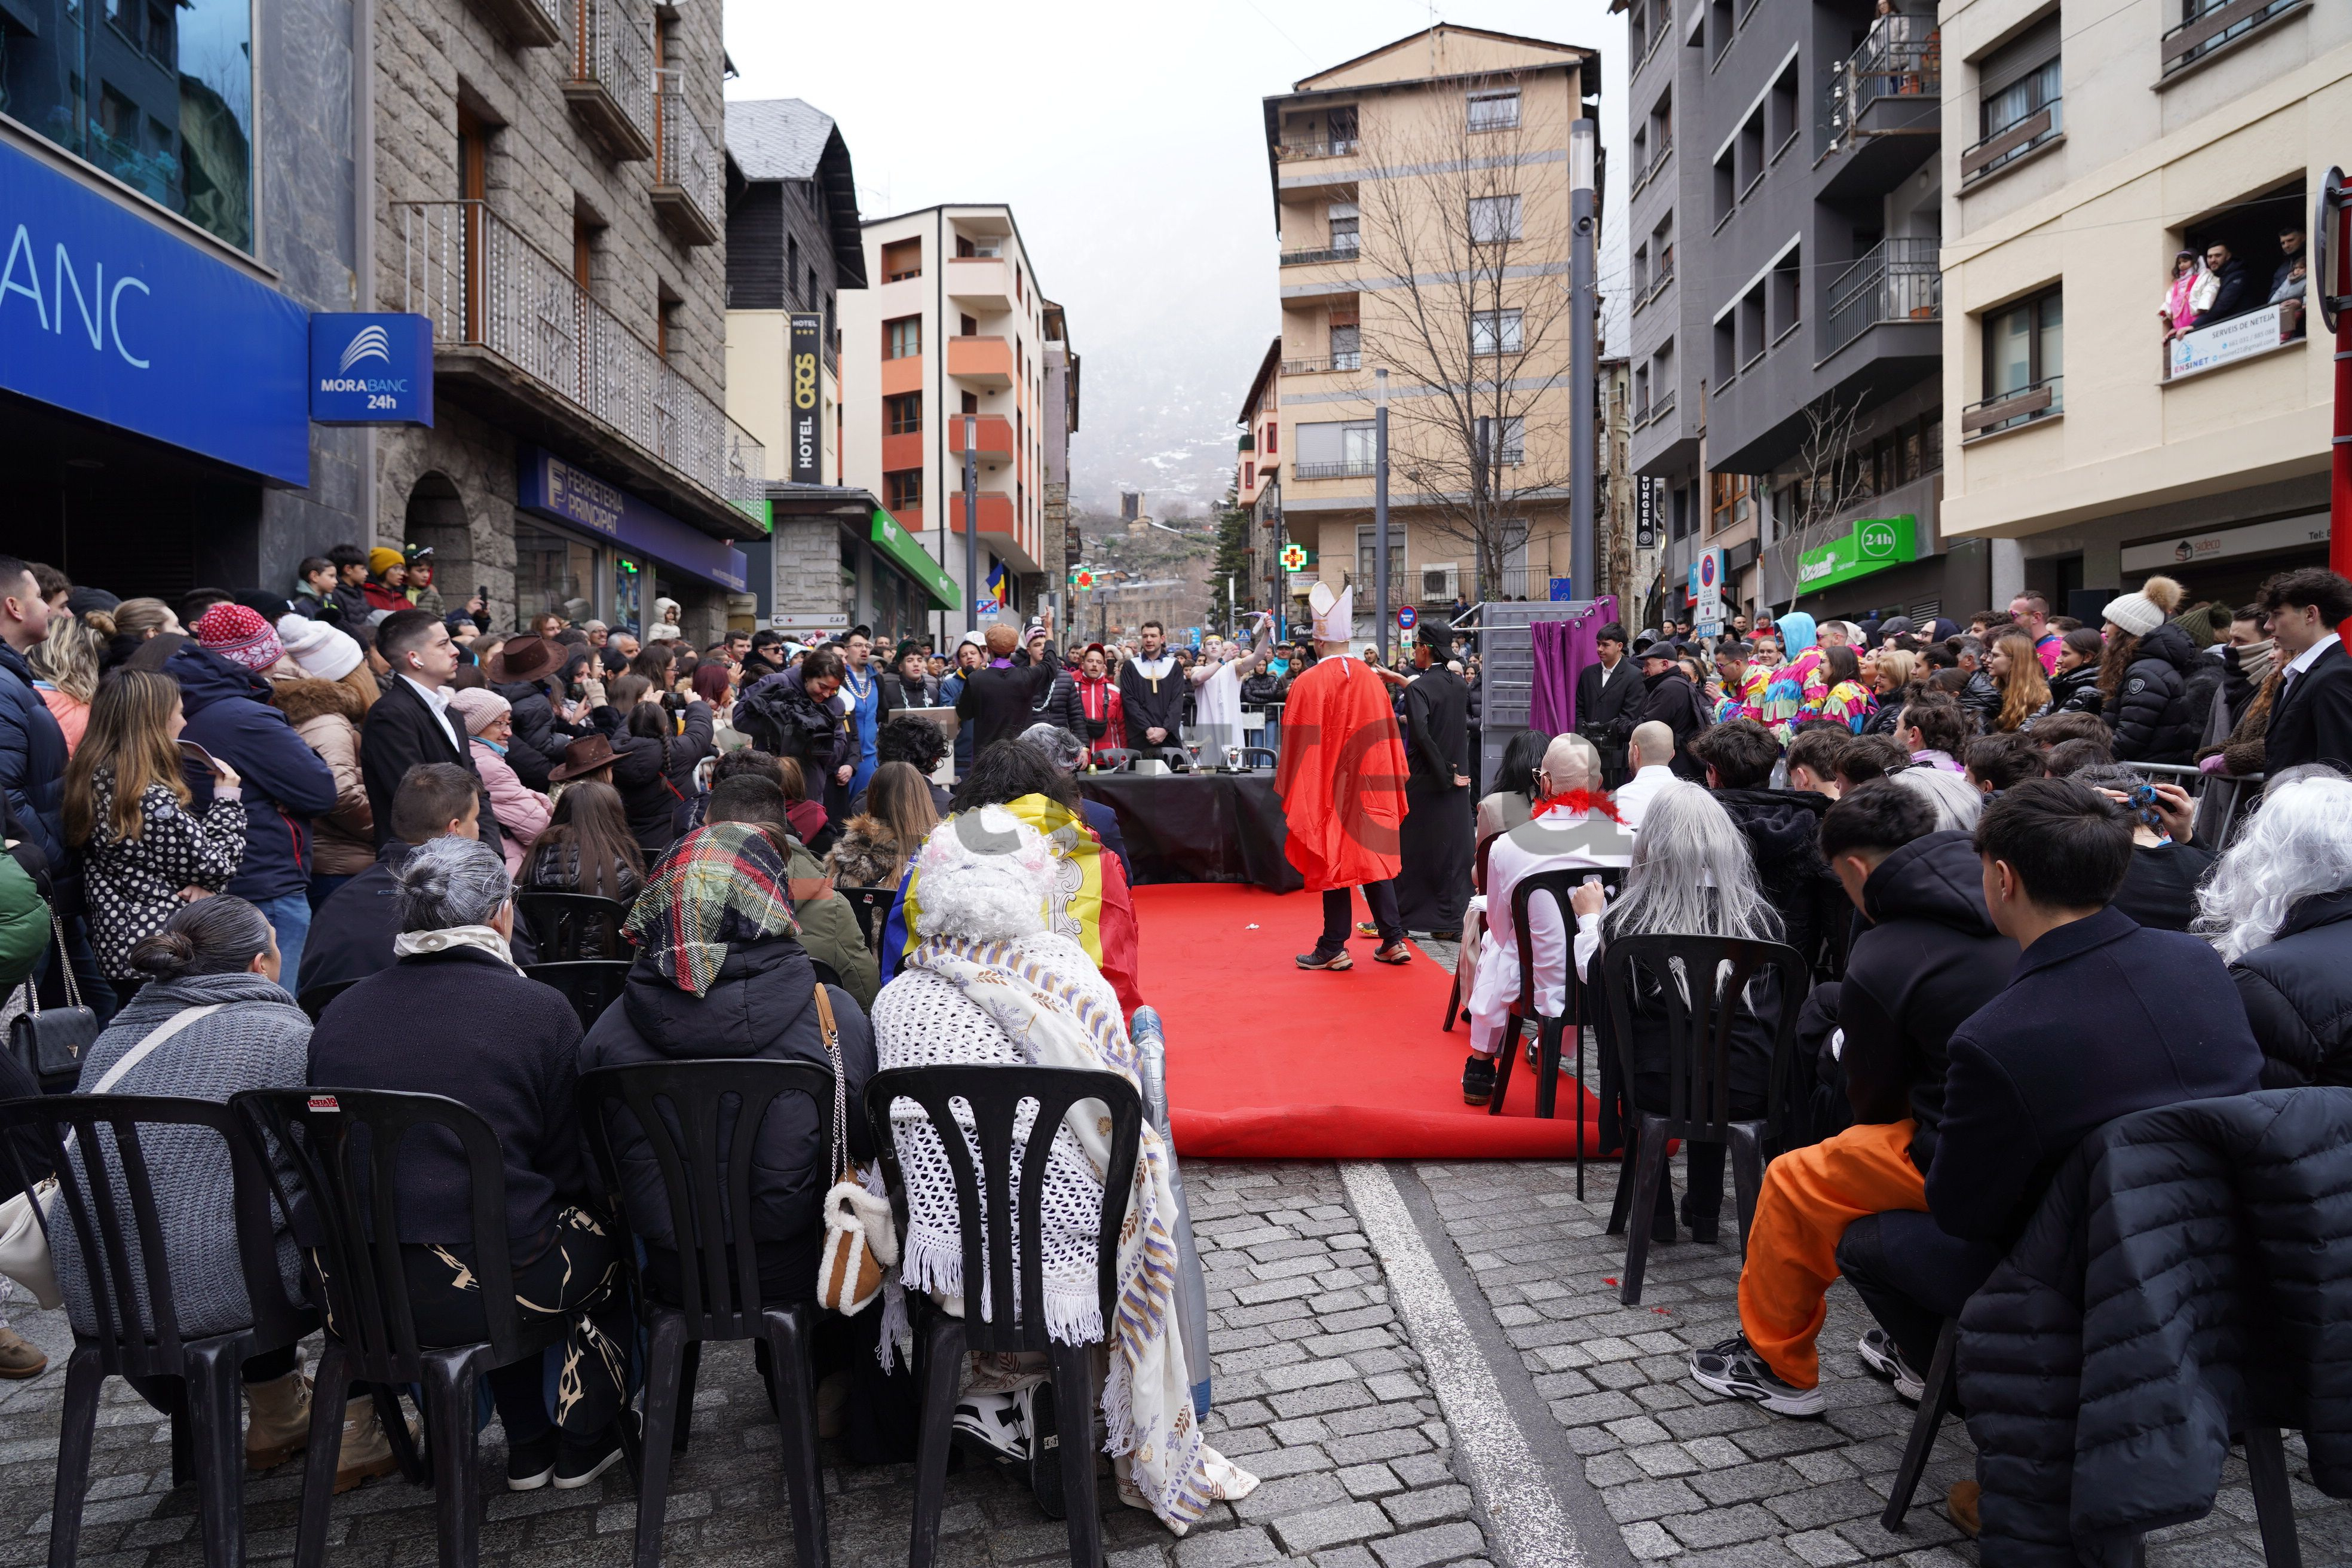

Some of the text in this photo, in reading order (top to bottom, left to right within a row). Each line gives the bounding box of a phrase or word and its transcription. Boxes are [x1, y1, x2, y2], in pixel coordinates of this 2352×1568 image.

[2212, 313, 2275, 339] SERVEIS DE NETEJA
[2174, 357, 2209, 373] ENSINET
[321, 378, 408, 393] MORABANC
[367, 394, 396, 410] 24h
[800, 416, 812, 469] HOTEL
[568, 467, 624, 514] FERRETERIA
[568, 494, 618, 535] PRINCIPAT
[1865, 533, 1892, 546] 24h
[2308, 530, 2324, 540] Tel:
